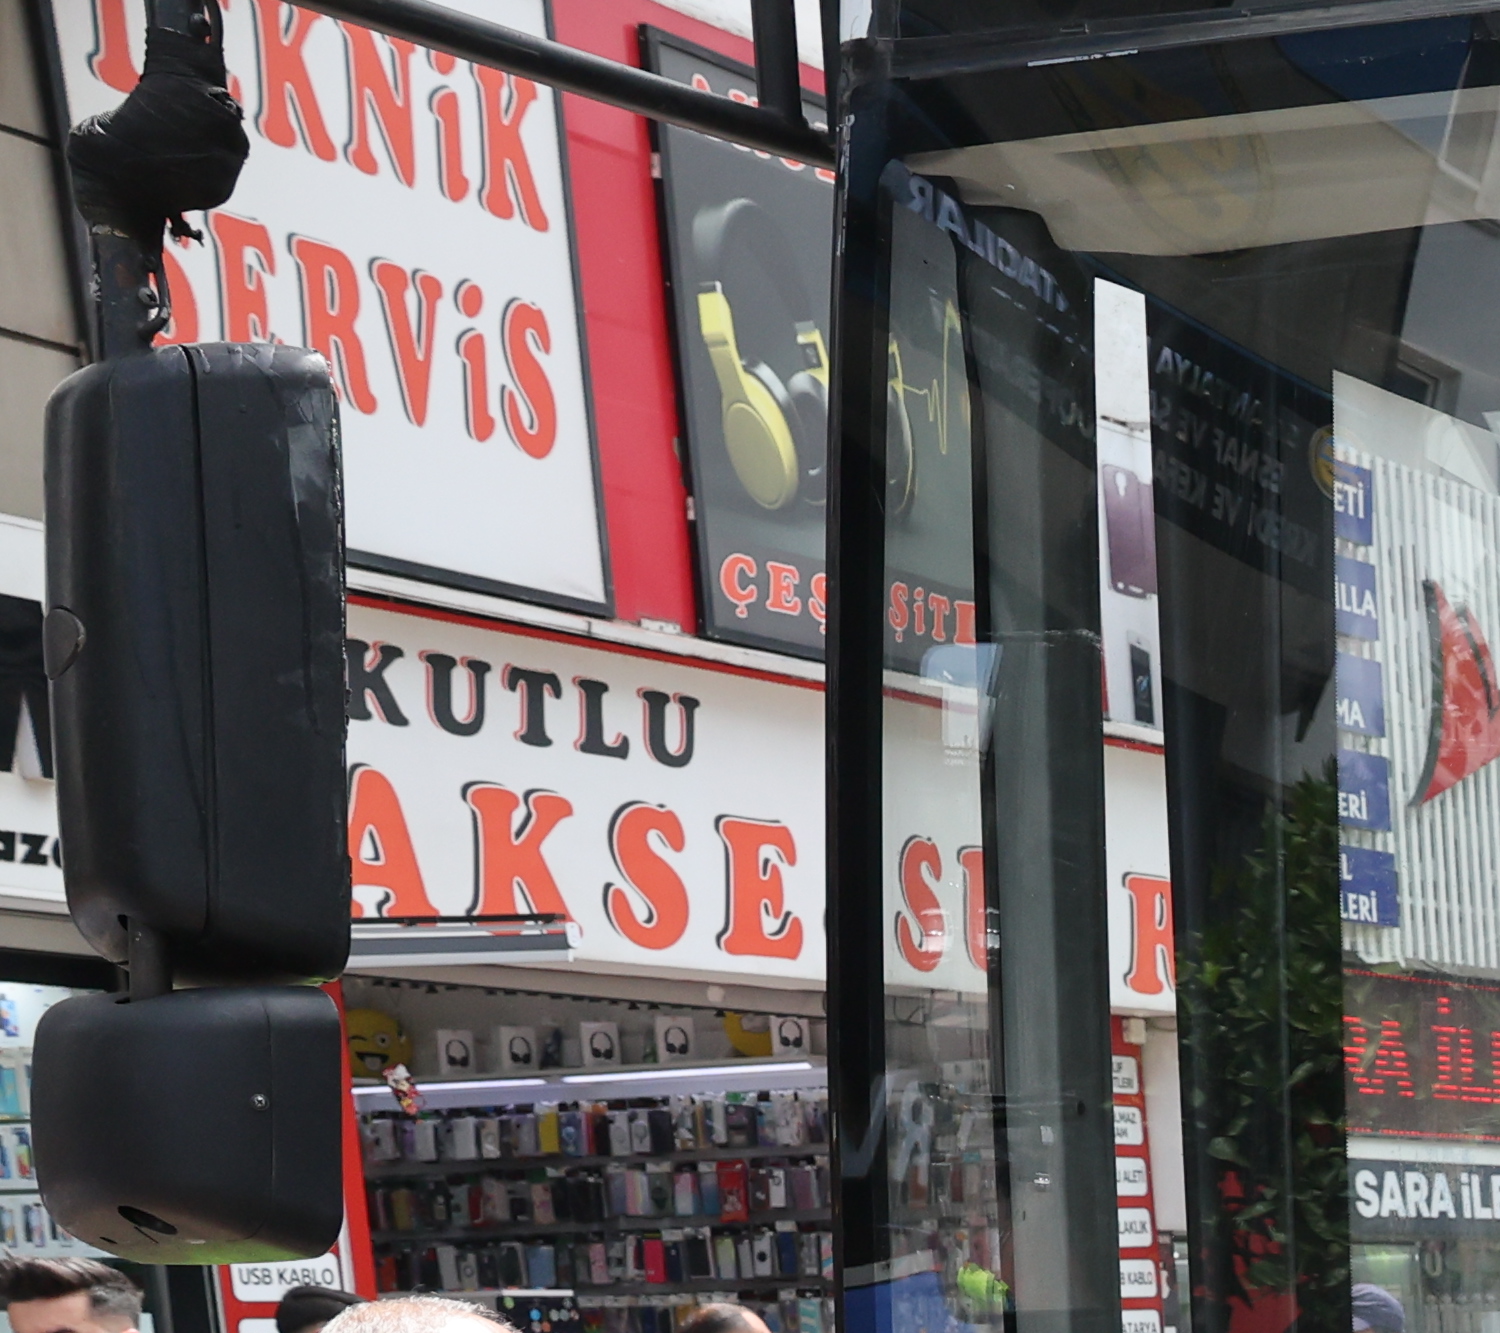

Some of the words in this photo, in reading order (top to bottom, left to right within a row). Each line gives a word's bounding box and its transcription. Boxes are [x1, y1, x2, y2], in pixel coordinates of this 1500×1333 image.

[347, 638, 701, 769] KUTLU
[1354, 1168, 1457, 1222] SARA
[238, 1266, 272, 1286] USB
